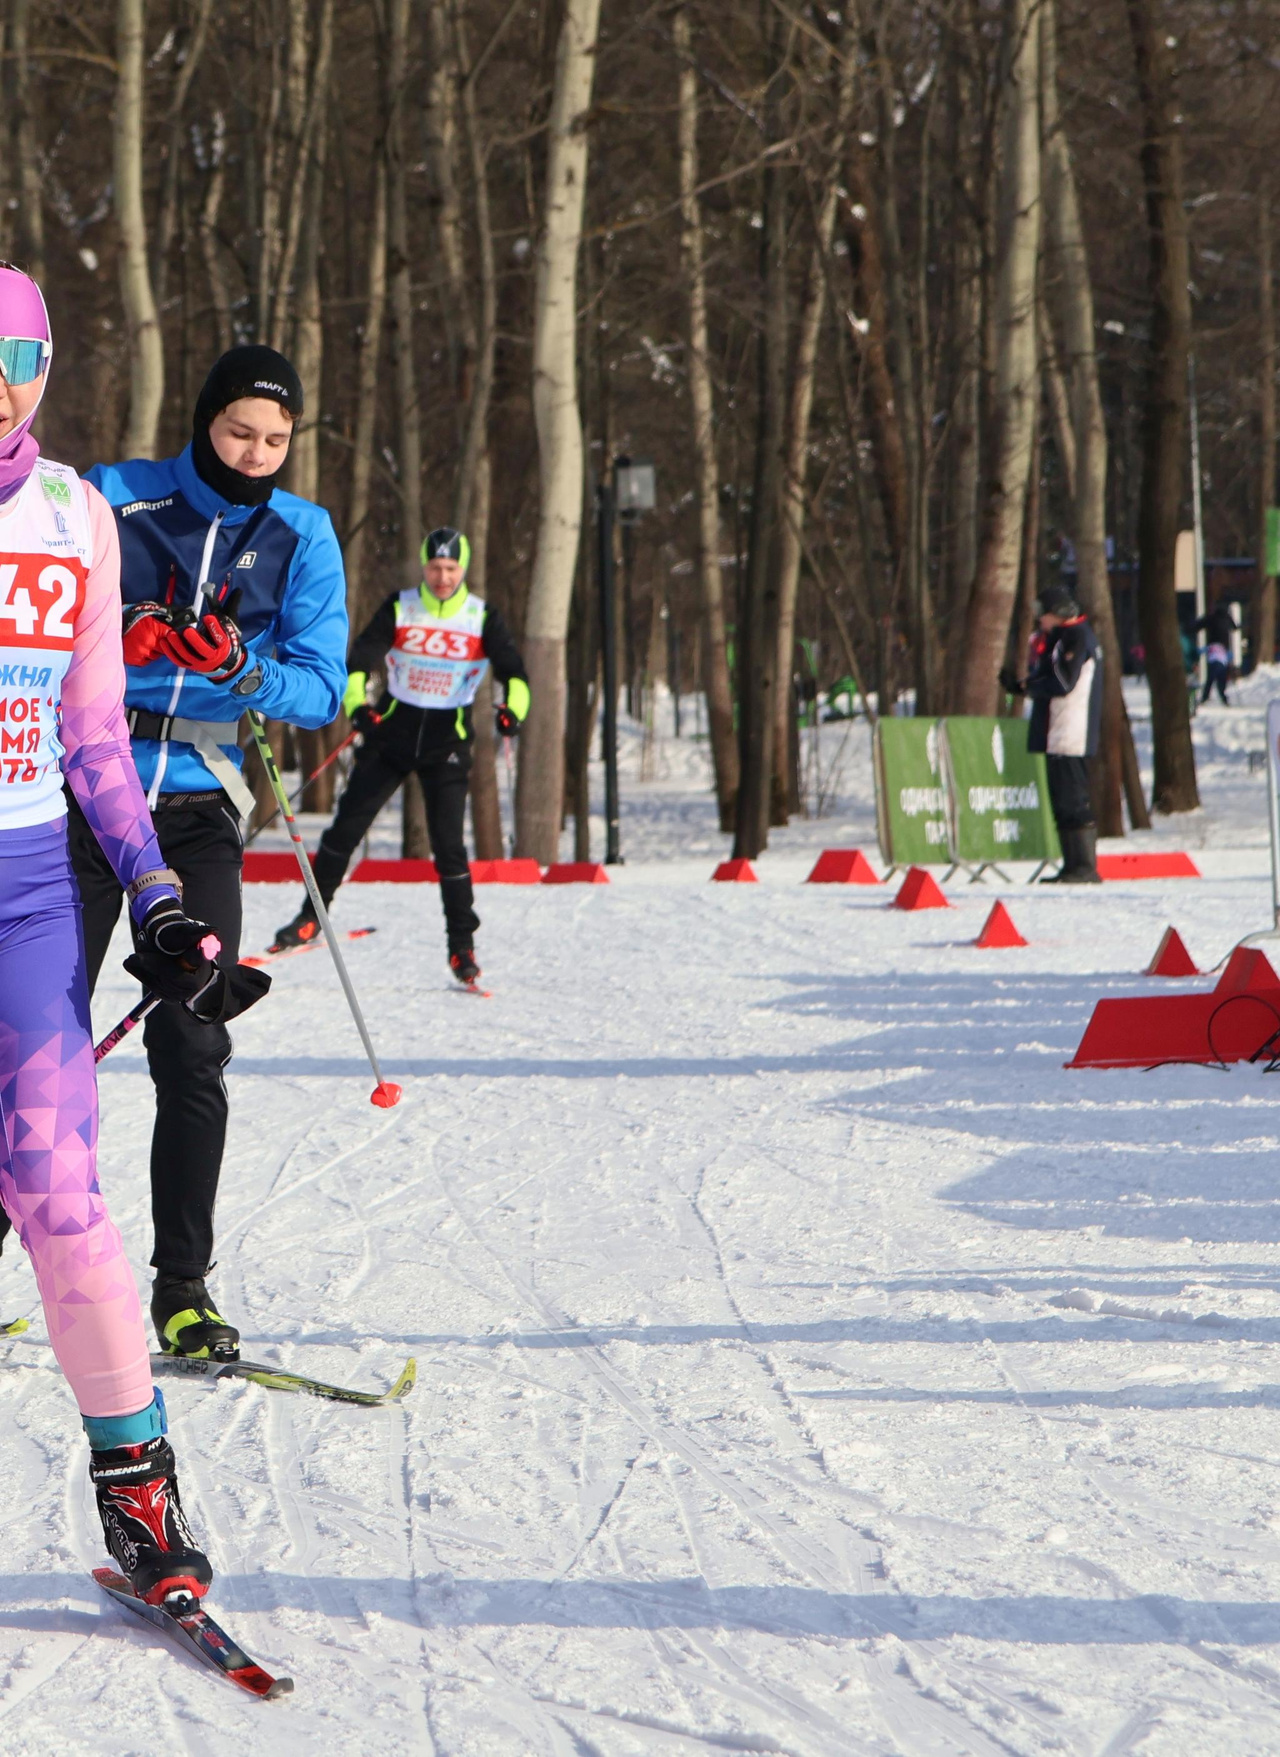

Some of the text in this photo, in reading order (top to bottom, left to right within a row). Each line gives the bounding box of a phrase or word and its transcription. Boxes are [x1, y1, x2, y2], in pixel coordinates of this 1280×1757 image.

[253, 380, 283, 393] CRAFT
[121, 498, 173, 517] noname
[401, 628, 469, 659] 263
